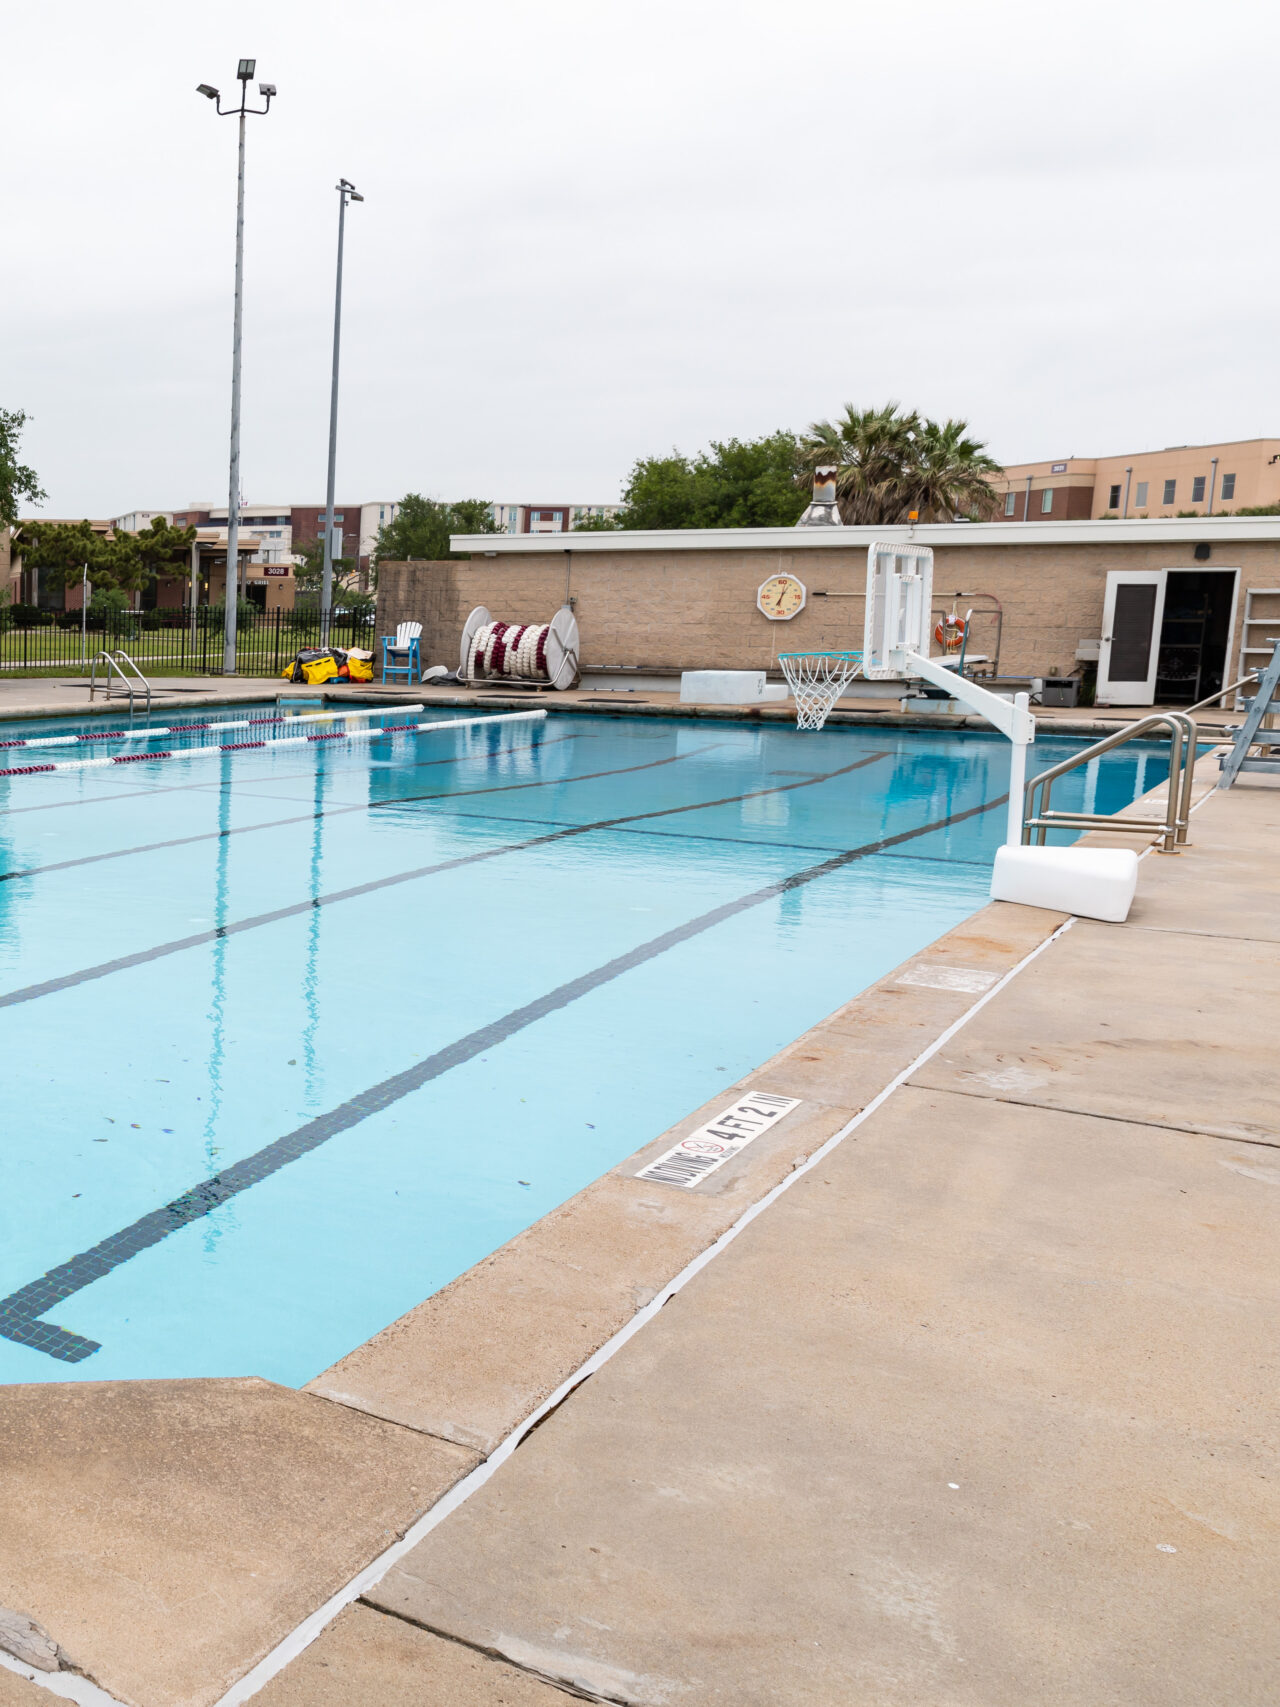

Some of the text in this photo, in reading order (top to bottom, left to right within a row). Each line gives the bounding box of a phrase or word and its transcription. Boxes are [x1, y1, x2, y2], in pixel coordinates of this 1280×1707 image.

[706, 1093, 794, 1141] 4 FT 2 IN
[641, 1152, 719, 1185] NO DIVING
